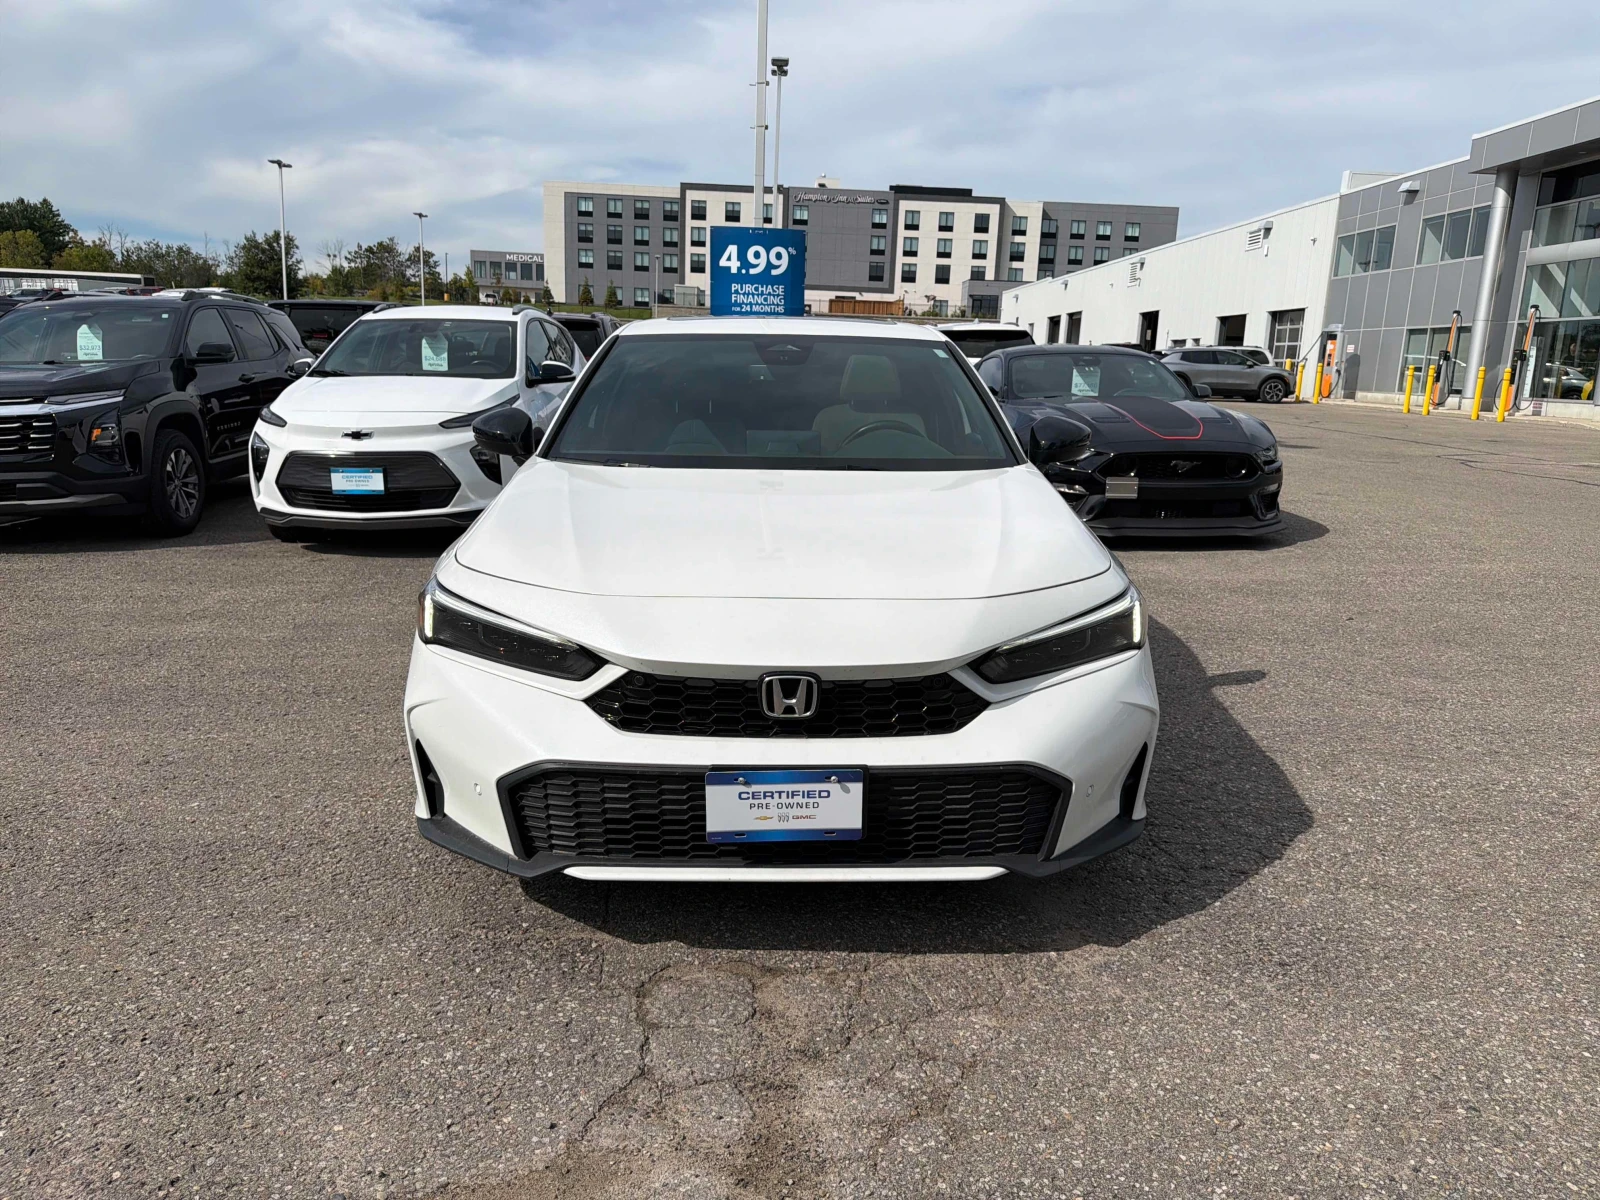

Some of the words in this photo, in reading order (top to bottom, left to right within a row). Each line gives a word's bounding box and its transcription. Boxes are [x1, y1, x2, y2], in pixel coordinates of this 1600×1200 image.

[793, 191, 830, 203] Hampton
[830, 194, 850, 203] Inn
[855, 194, 875, 204] Suites
[506, 253, 544, 263] MEDICAL
[719, 244, 797, 276] 4.99%
[731, 283, 785, 295] PURCHASE
[731, 294, 785, 305] FINANCING
[741, 304, 751, 312] 24
[752, 305, 785, 313] MONTHS
[738, 789, 831, 801] CERTIFIED
[749, 801, 820, 810] PRE-OWNED
